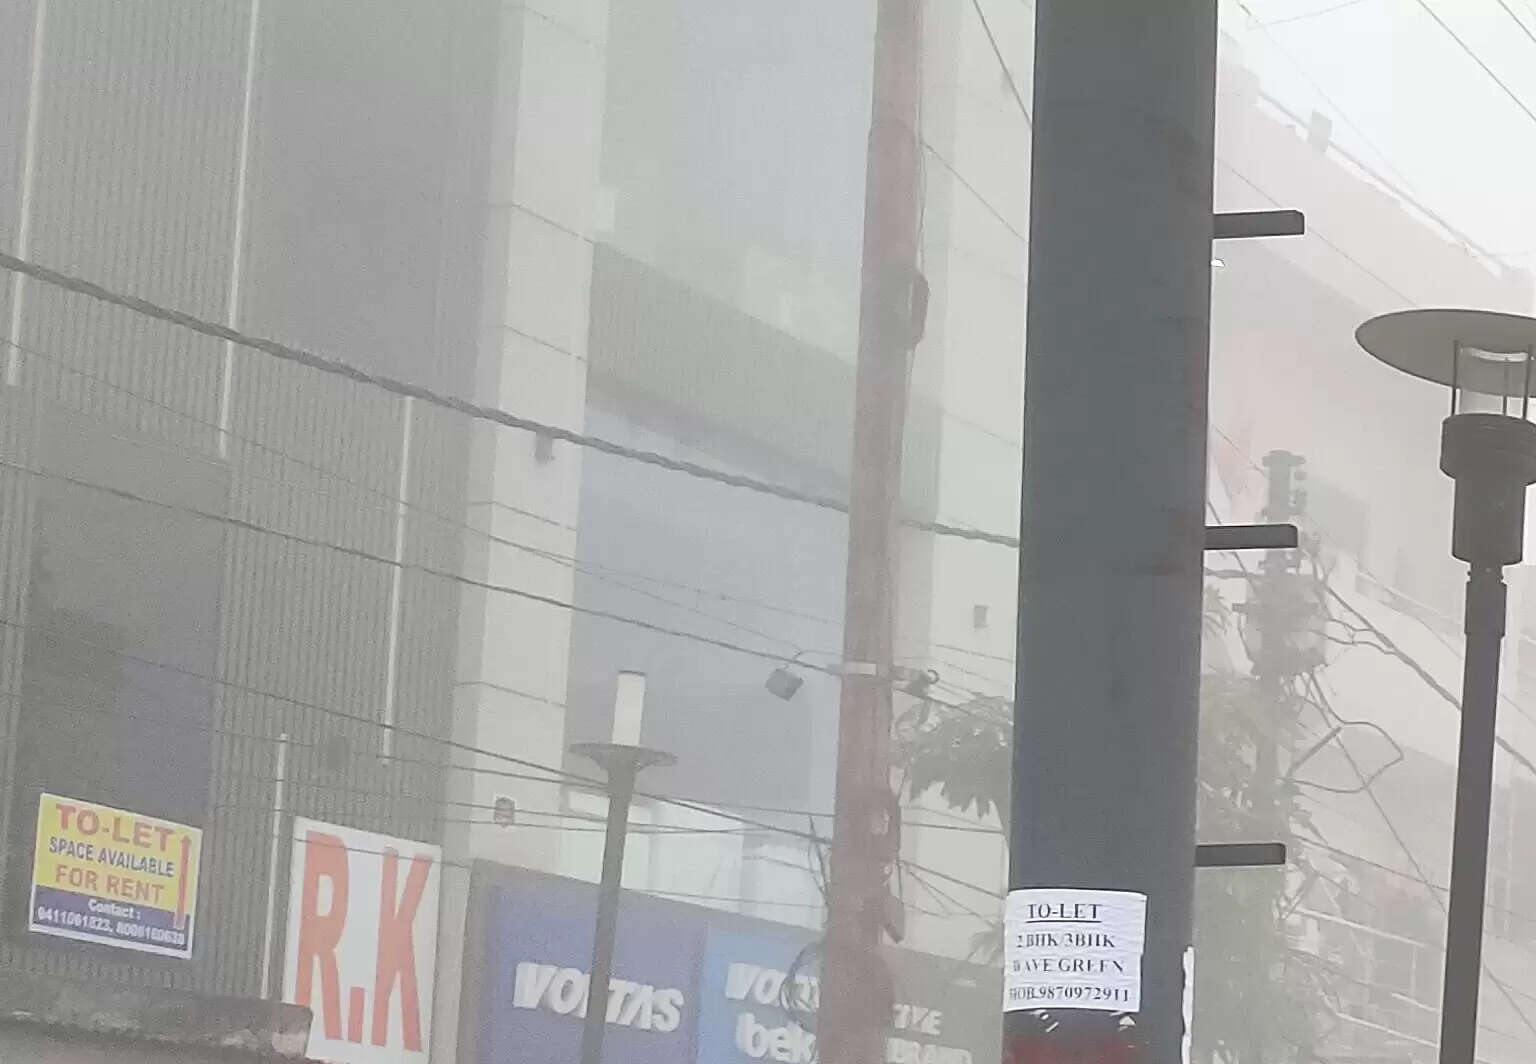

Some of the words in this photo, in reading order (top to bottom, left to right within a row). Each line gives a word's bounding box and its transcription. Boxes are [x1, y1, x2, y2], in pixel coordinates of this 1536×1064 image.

[56, 803, 175, 852] TO-LET
[49, 836, 94, 862] SPACE
[97, 848, 175, 878] AVAILABLE
[55, 863, 97, 892] FOR
[106, 875, 165, 904] RENT
[1027, 903, 1103, 920] TO-LET
[1058, 958, 1124, 973] GREEN
